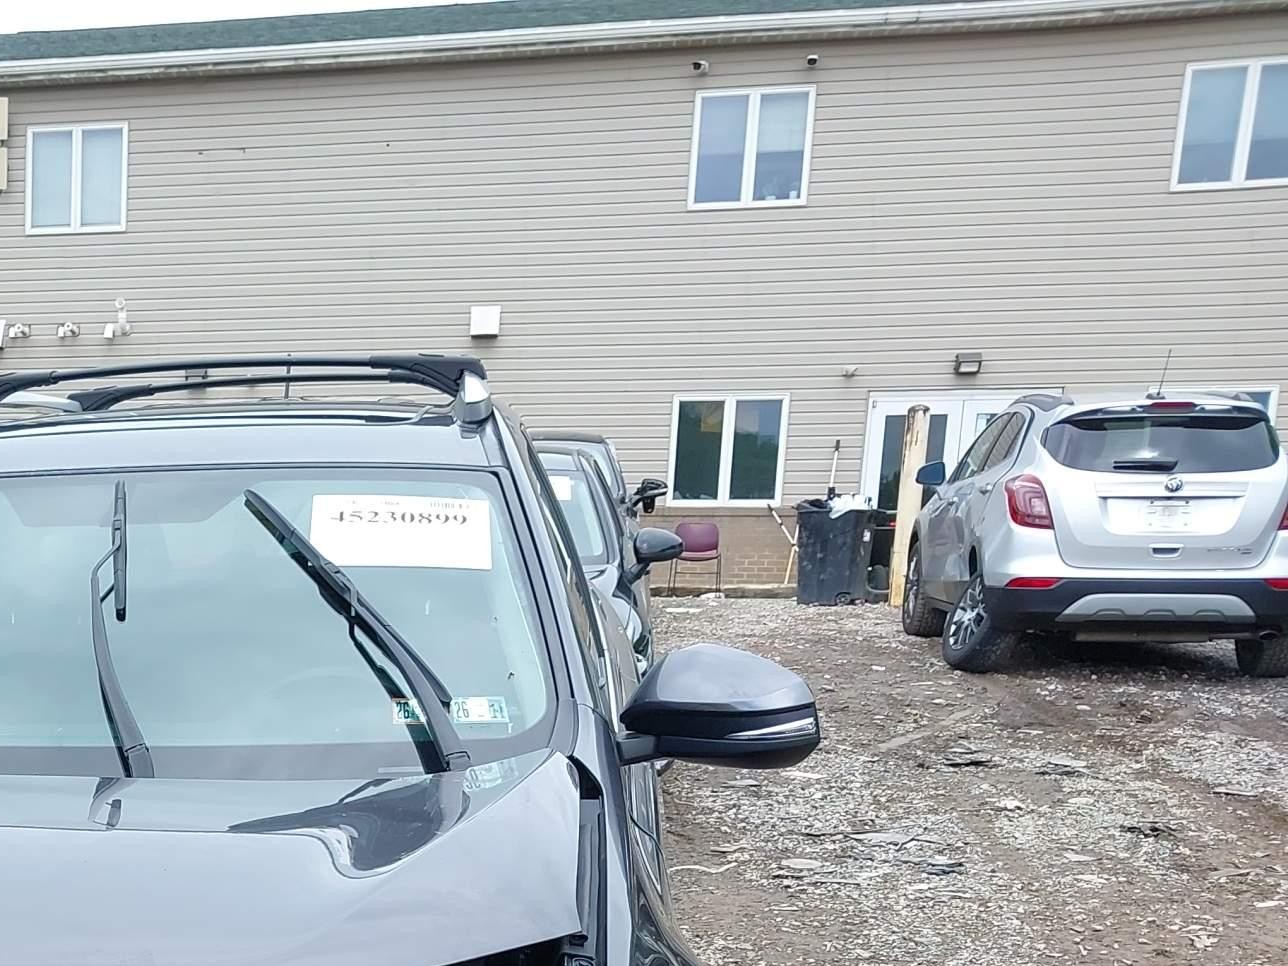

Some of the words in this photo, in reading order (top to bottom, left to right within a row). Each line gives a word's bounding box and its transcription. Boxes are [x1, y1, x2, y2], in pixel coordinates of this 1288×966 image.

[330, 510, 468, 525] 45230899
[396, 700, 410, 719] 26
[454, 701, 469, 718] 26
